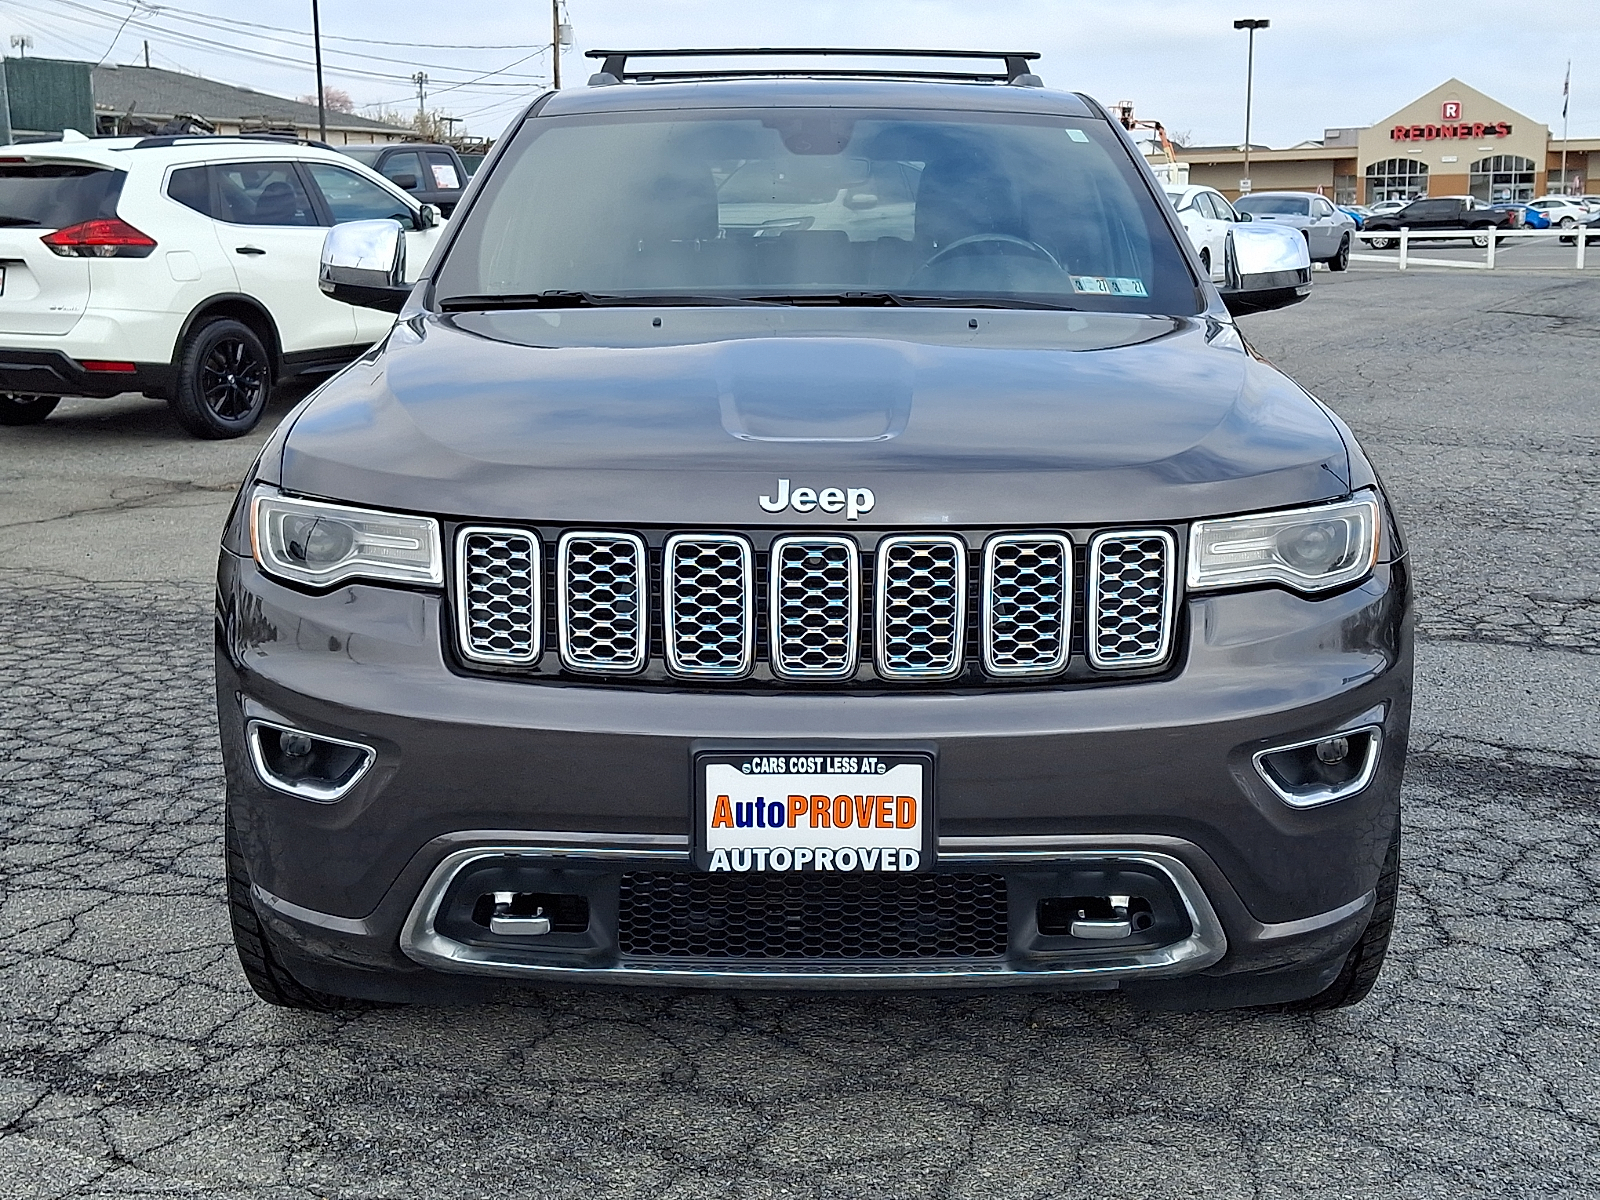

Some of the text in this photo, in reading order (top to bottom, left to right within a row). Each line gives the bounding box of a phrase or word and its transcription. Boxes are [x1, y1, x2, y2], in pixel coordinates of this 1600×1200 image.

[1446, 104, 1457, 117] R
[1393, 122, 1508, 140] REDNER'S
[759, 478, 875, 521] Jeep
[752, 757, 877, 773] CARS COST LESS AT
[711, 795, 917, 829] AutoPROVED
[709, 847, 920, 873] AUTOPROVED
